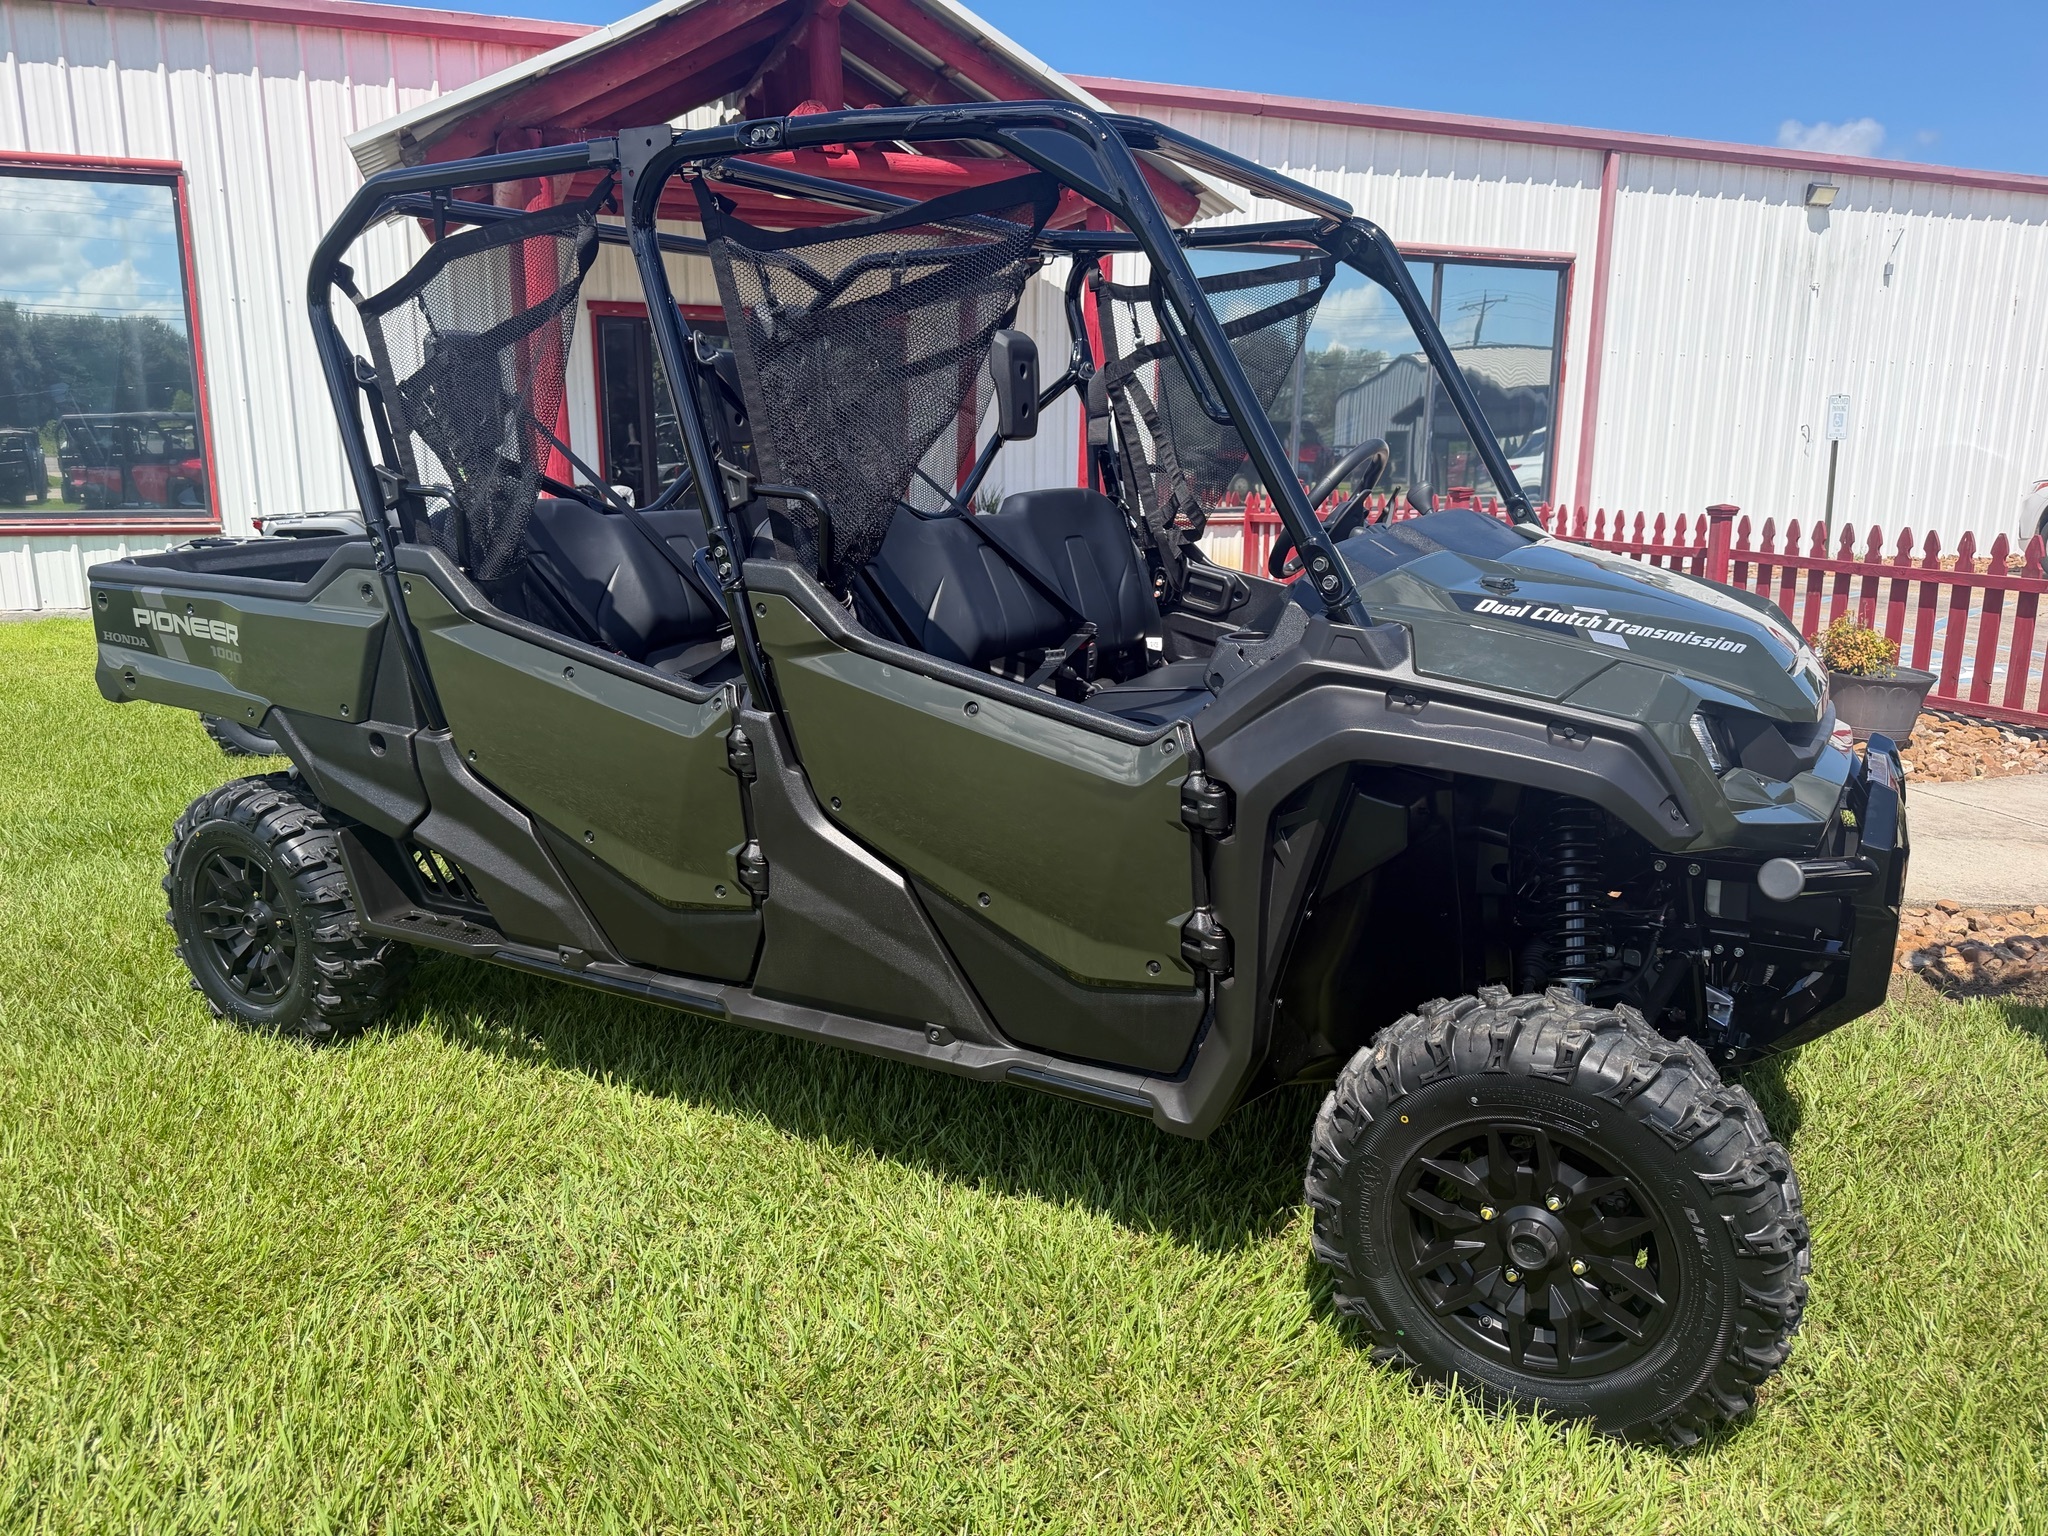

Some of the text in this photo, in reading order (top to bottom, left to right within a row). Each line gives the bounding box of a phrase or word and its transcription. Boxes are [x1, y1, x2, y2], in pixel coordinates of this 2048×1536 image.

[103, 630, 150, 648] HONDA
[132, 607, 239, 647] PIONEER
[1473, 598, 1747, 655] Dual Clutch Transmission
[210, 645, 243, 664] 1000
